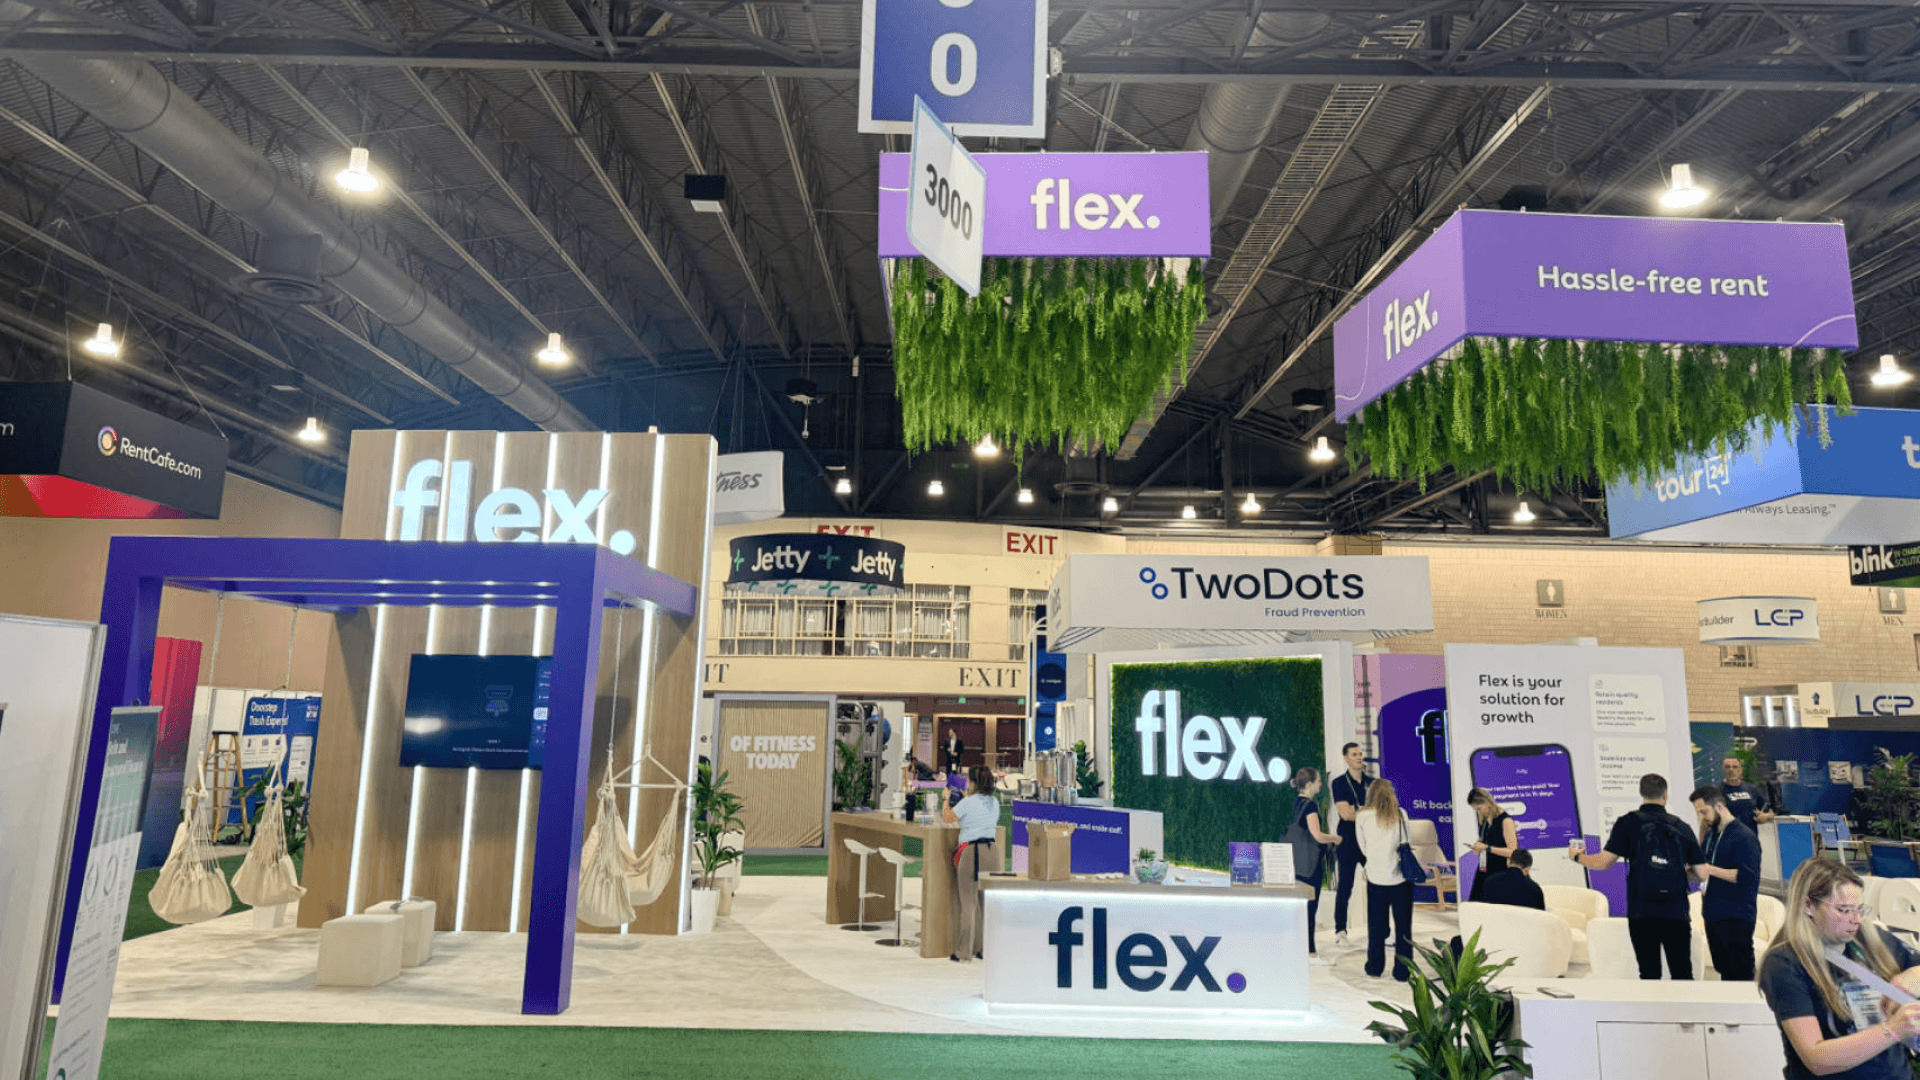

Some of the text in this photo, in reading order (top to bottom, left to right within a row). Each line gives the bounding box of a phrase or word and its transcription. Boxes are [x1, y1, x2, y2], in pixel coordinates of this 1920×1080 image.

[925, 163, 973, 241] 3000
[1031, 177, 1161, 231] flex.
[1537, 264, 1769, 296] Hassle-free rent
[1382, 289, 1439, 362] flex.
[119, 436, 201, 480] RentCafe.com
[1655, 468, 1704, 503] tour
[393, 459, 637, 556] flex.
[1006, 532, 1059, 555] EXIT
[751, 545, 811, 574] Jetty
[850, 548, 897, 582] Jetty
[1849, 545, 1895, 576] blink
[1170, 567, 1365, 600] TwoDots
[1264, 607, 1366, 618] Fraud Prevention
[1754, 609, 1804, 626] LCP
[959, 667, 1021, 688] EXIT
[1479, 674, 1562, 690] Flex is your
[1480, 692, 1565, 705] solution for
[1855, 695, 1914, 716] LCP
[1480, 711, 1534, 725] growth
[730, 735, 752, 752] OF
[753, 735, 816, 752] FITNESS
[1135, 690, 1292, 784] flex.
[746, 752, 800, 769] TODAY
[1413, 799, 1427, 810] Sit
[1049, 906, 1247, 993] flex.
